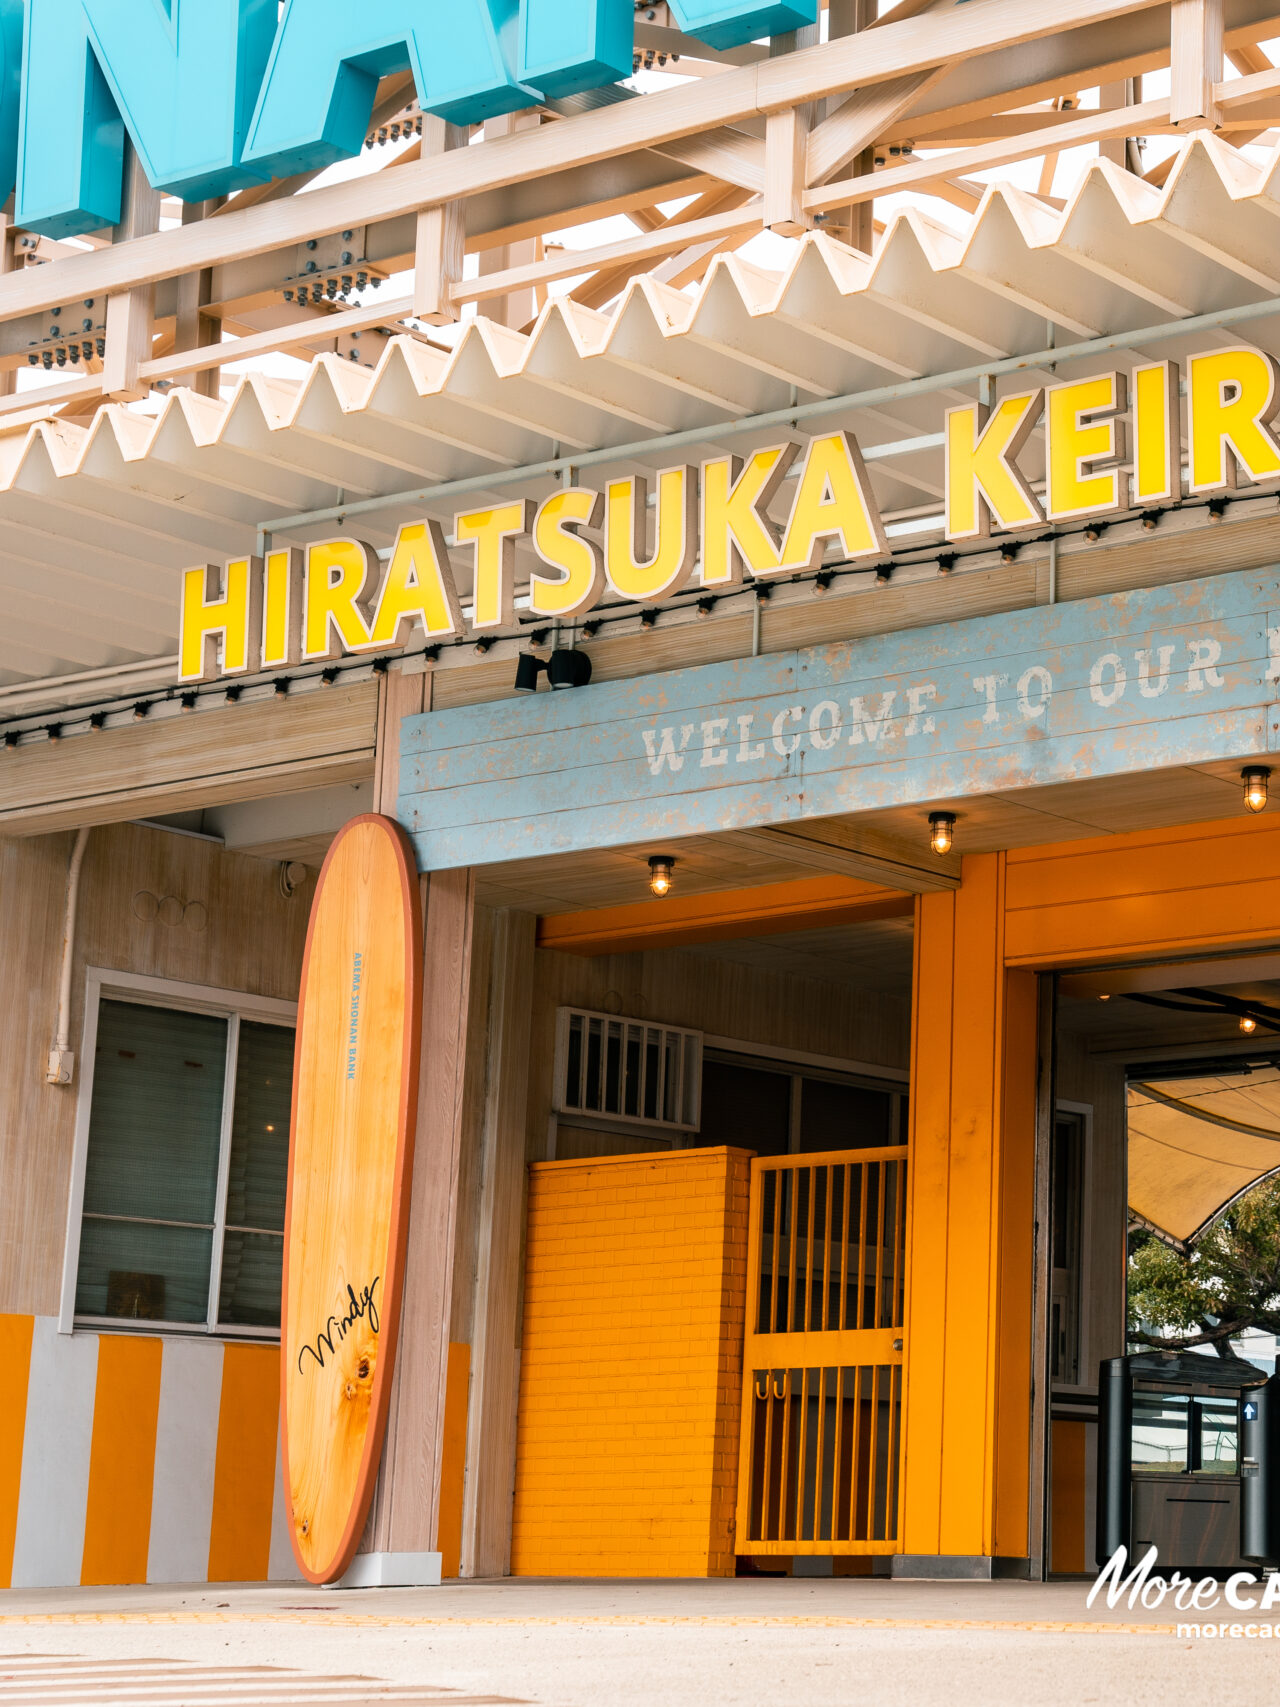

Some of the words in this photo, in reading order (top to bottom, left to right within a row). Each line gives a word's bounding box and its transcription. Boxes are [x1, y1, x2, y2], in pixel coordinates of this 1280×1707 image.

[178, 429, 888, 682] HIRATSUKA
[641, 683, 938, 776] WELCOME
[972, 664, 1054, 725] TO
[1088, 638, 1226, 708] OUR
[351, 952, 362, 992] ABEMA
[349, 995, 360, 1044] SHONAN
[347, 1048, 357, 1080] BANK
[298, 1275, 380, 1375] Windy
